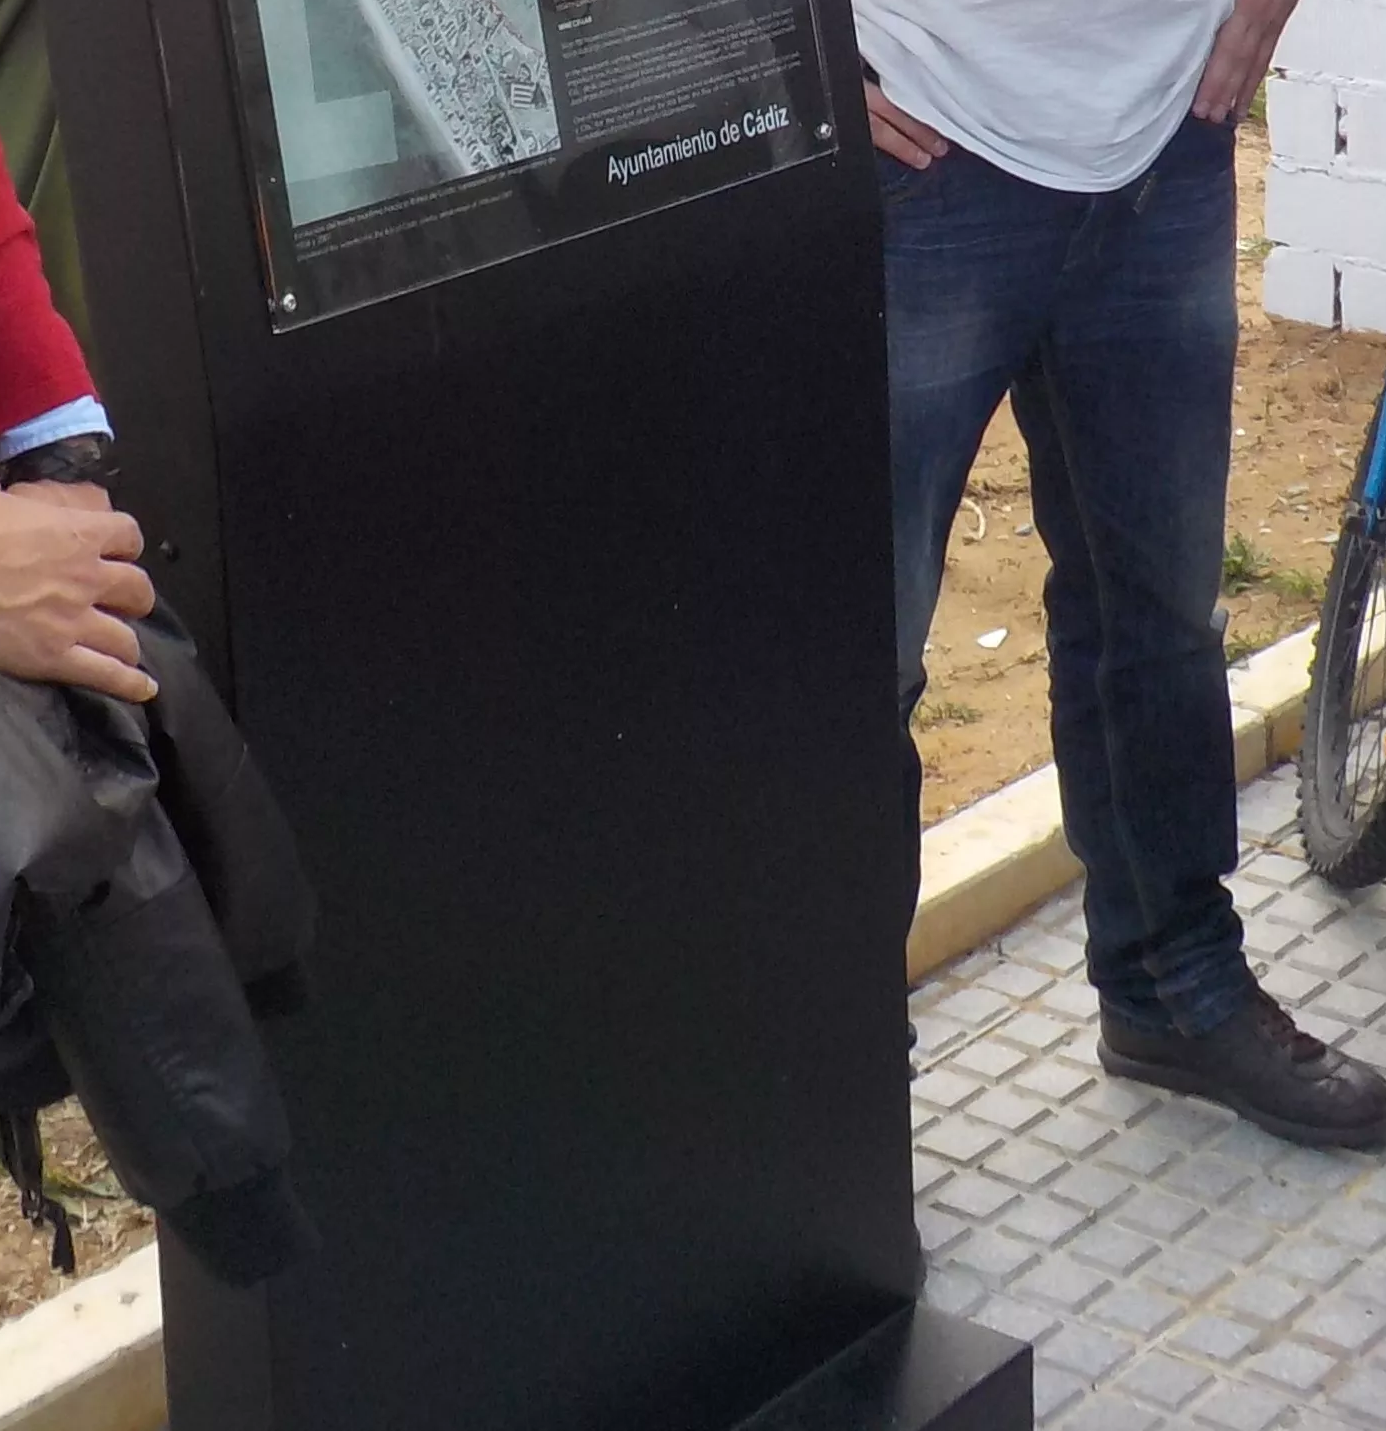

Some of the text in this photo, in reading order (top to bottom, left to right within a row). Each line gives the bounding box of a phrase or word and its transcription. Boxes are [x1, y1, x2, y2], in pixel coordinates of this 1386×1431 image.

[607, 103, 790, 186] Ayuntamiento de Cádiz
